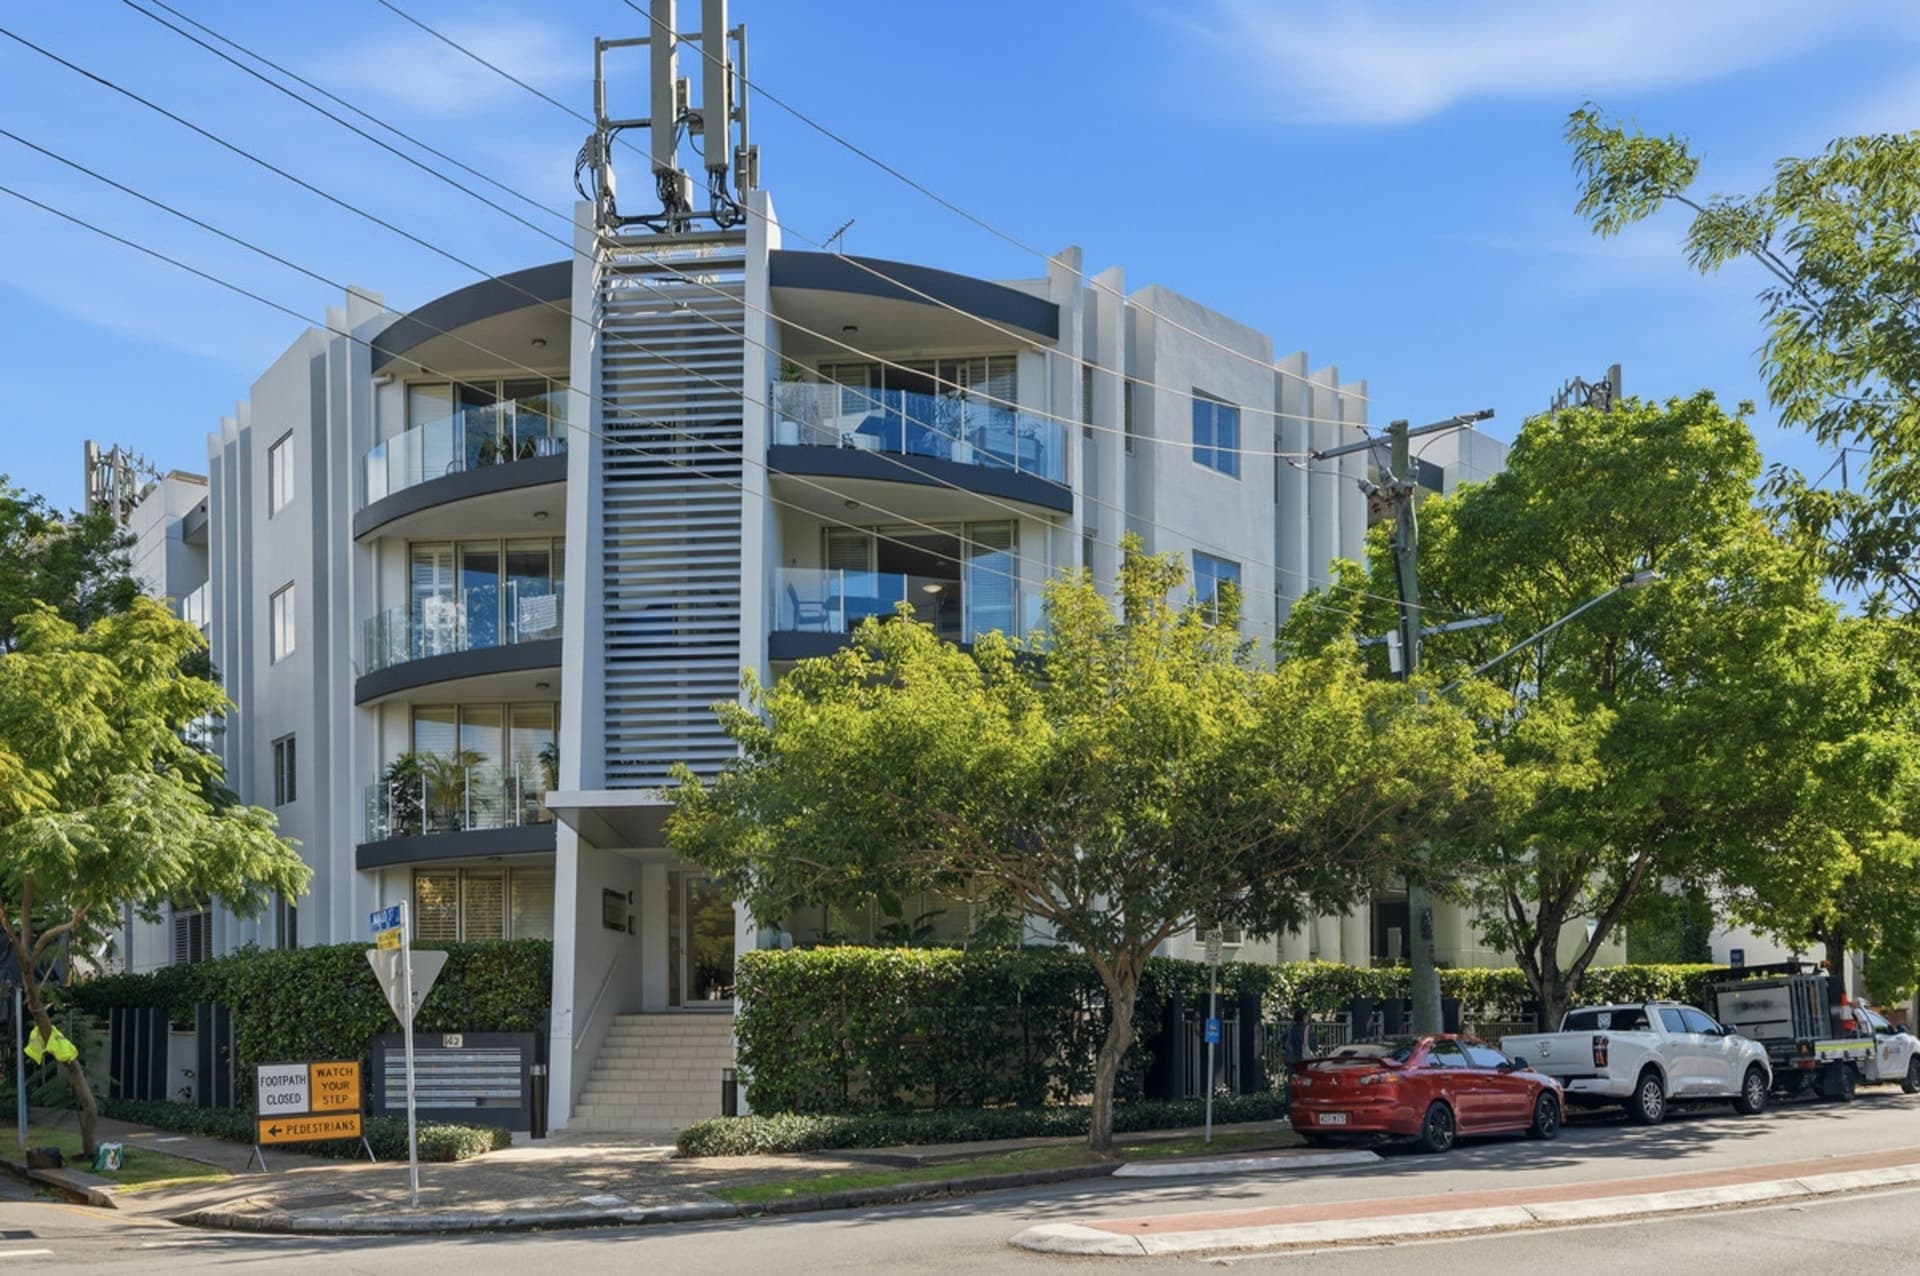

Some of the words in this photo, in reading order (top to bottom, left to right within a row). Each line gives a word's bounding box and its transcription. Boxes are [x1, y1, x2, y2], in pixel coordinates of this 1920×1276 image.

[317, 1067, 353, 1078] WATCH
[260, 1075, 306, 1087] FOOTPATH
[321, 1081, 350, 1091] YOUR
[266, 1093, 301, 1106] CLOSED
[322, 1094, 349, 1105] STEP
[286, 1120, 355, 1135] PEDESTRIANS
